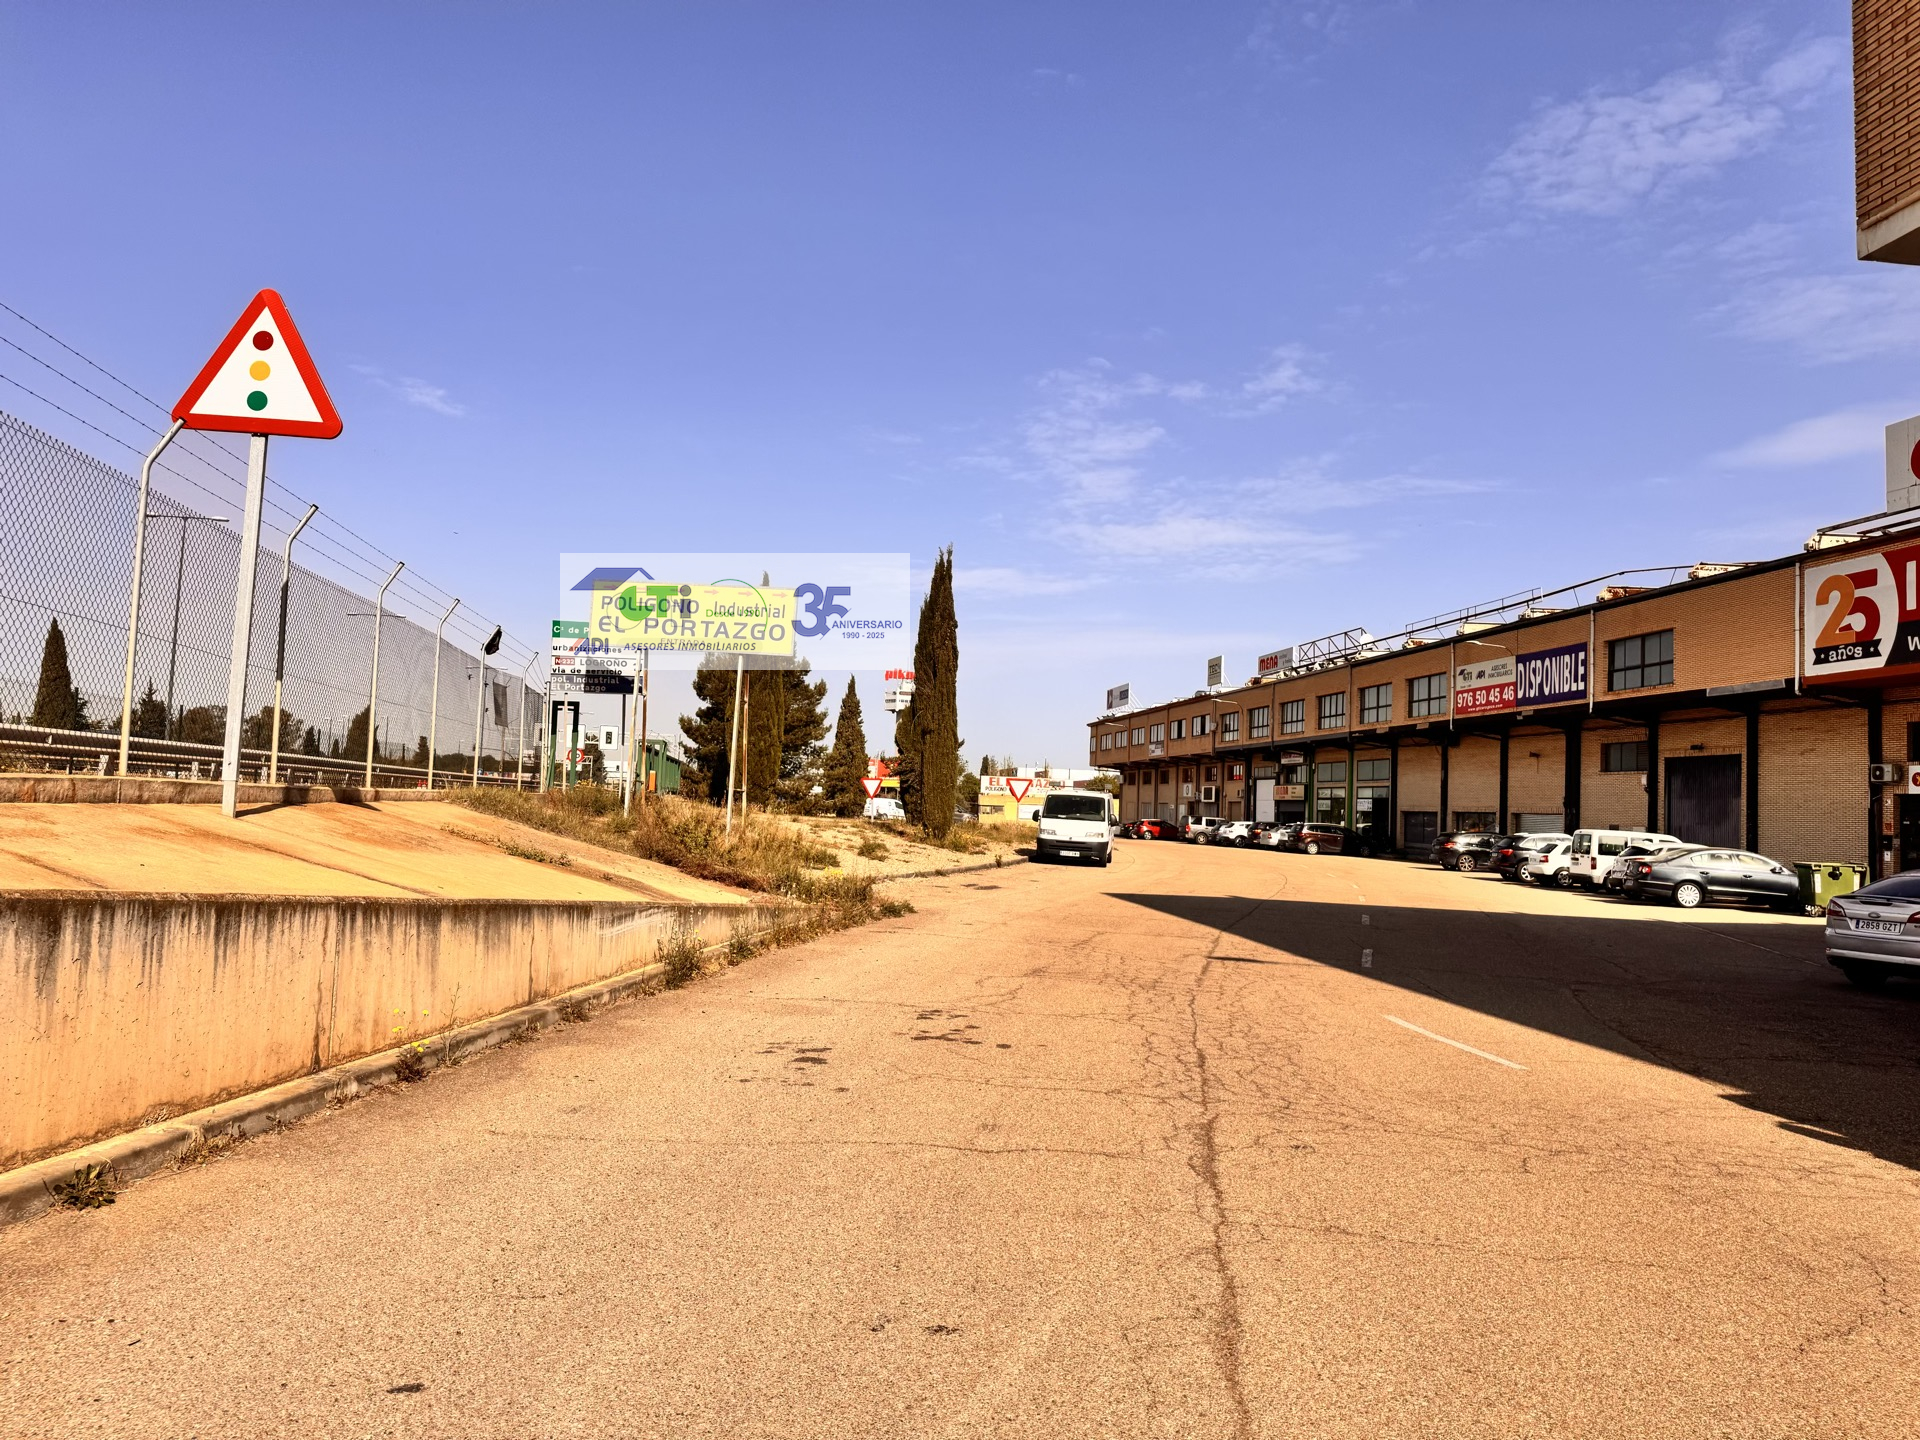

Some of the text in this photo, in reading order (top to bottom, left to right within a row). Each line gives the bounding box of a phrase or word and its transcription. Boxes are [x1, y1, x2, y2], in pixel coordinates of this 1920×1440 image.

[714, 601, 786, 619] Industrial
[1815, 567, 1881, 648] 25
[598, 616, 786, 641] EL PORTAZGO
[552, 644, 622, 653] urbanizaciones
[1829, 645, 1863, 661] años
[1259, 655, 1278, 672] MENA
[551, 676, 619, 684] pol. Industrial
[1517, 651, 1586, 699] DISPONIBLE
[551, 683, 607, 692] El Portazgo
[1457, 686, 1515, 707] 976 50 45 46
[1882, 922, 1898, 932] GZT
